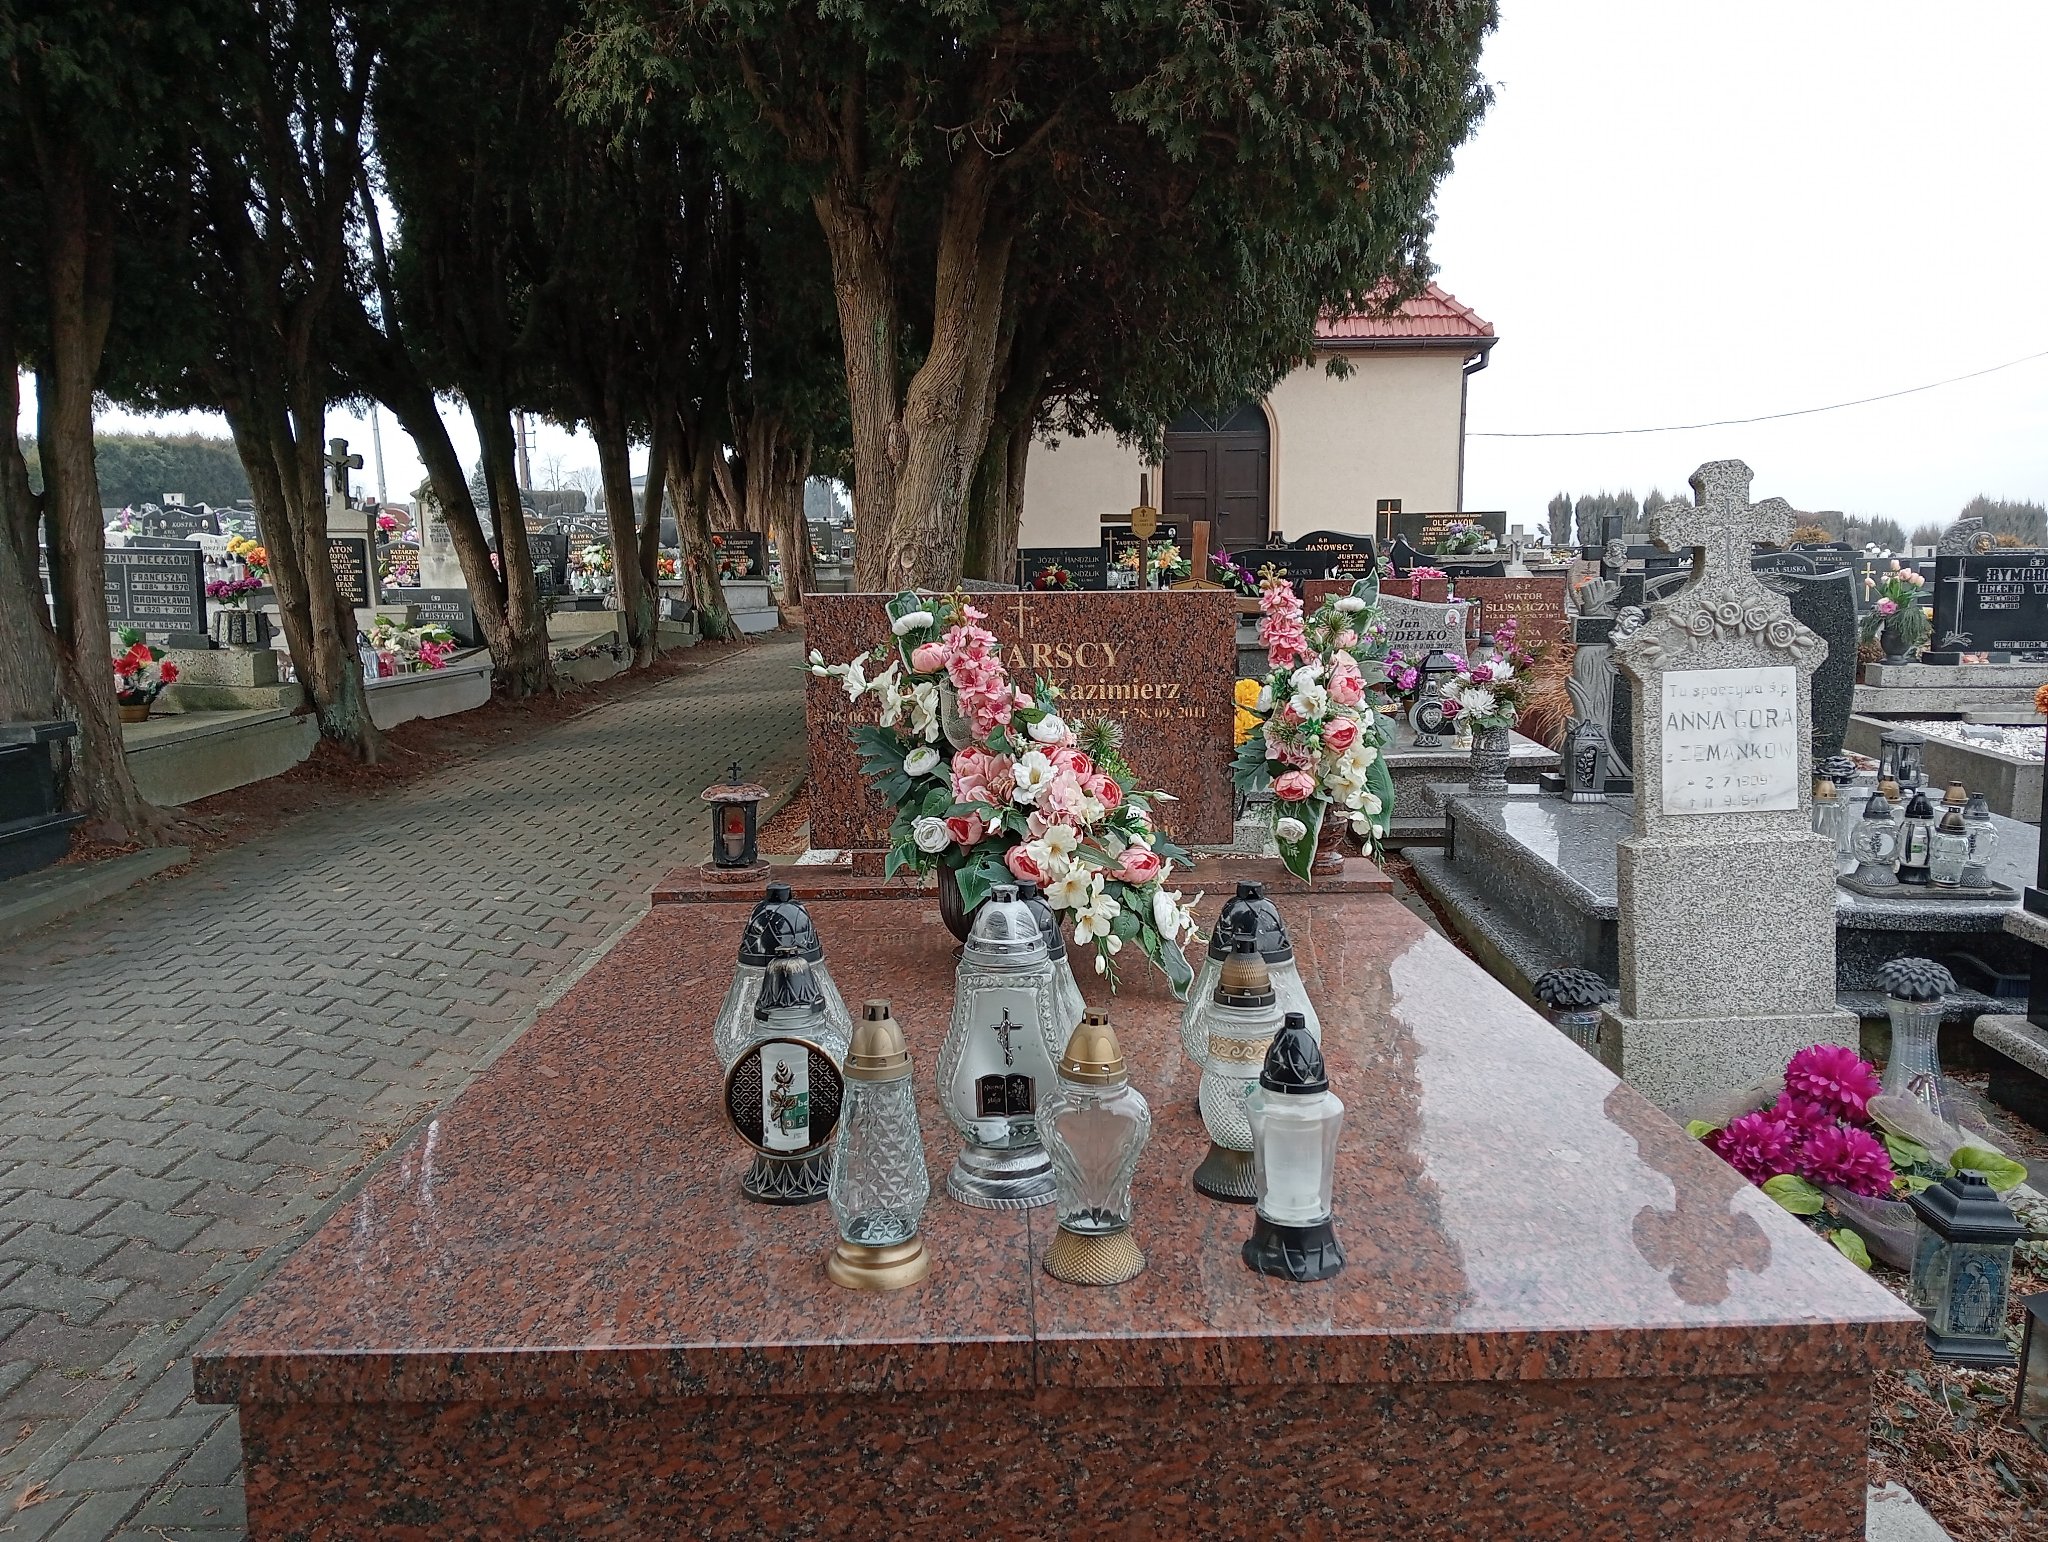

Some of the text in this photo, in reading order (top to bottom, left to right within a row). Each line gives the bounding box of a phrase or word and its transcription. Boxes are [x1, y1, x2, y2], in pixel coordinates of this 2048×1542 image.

[1305, 543, 1354, 551] JANOWSCY
[137, 553, 190, 565] PIECZKÓW
[1782, 565, 1807, 573] SUSKA
[1977, 584, 2024, 594] HELENA
[133, 595, 191, 605] BRONISŁAWA
[1504, 592, 1543, 600] WIKTOR
[1485, 601, 1559, 612] ŚLUSARCZYK
[159, 622, 191, 631] NASZYM
[1396, 619, 1420, 629] Jan
[999, 642, 1123, 669] ARSCY
[1052, 677, 1182, 700] Kazimierz
[1668, 684, 1687, 697] Tu
[1692, 683, 1764, 699] spoczywa
[1664, 710, 1728, 732] ANNA
